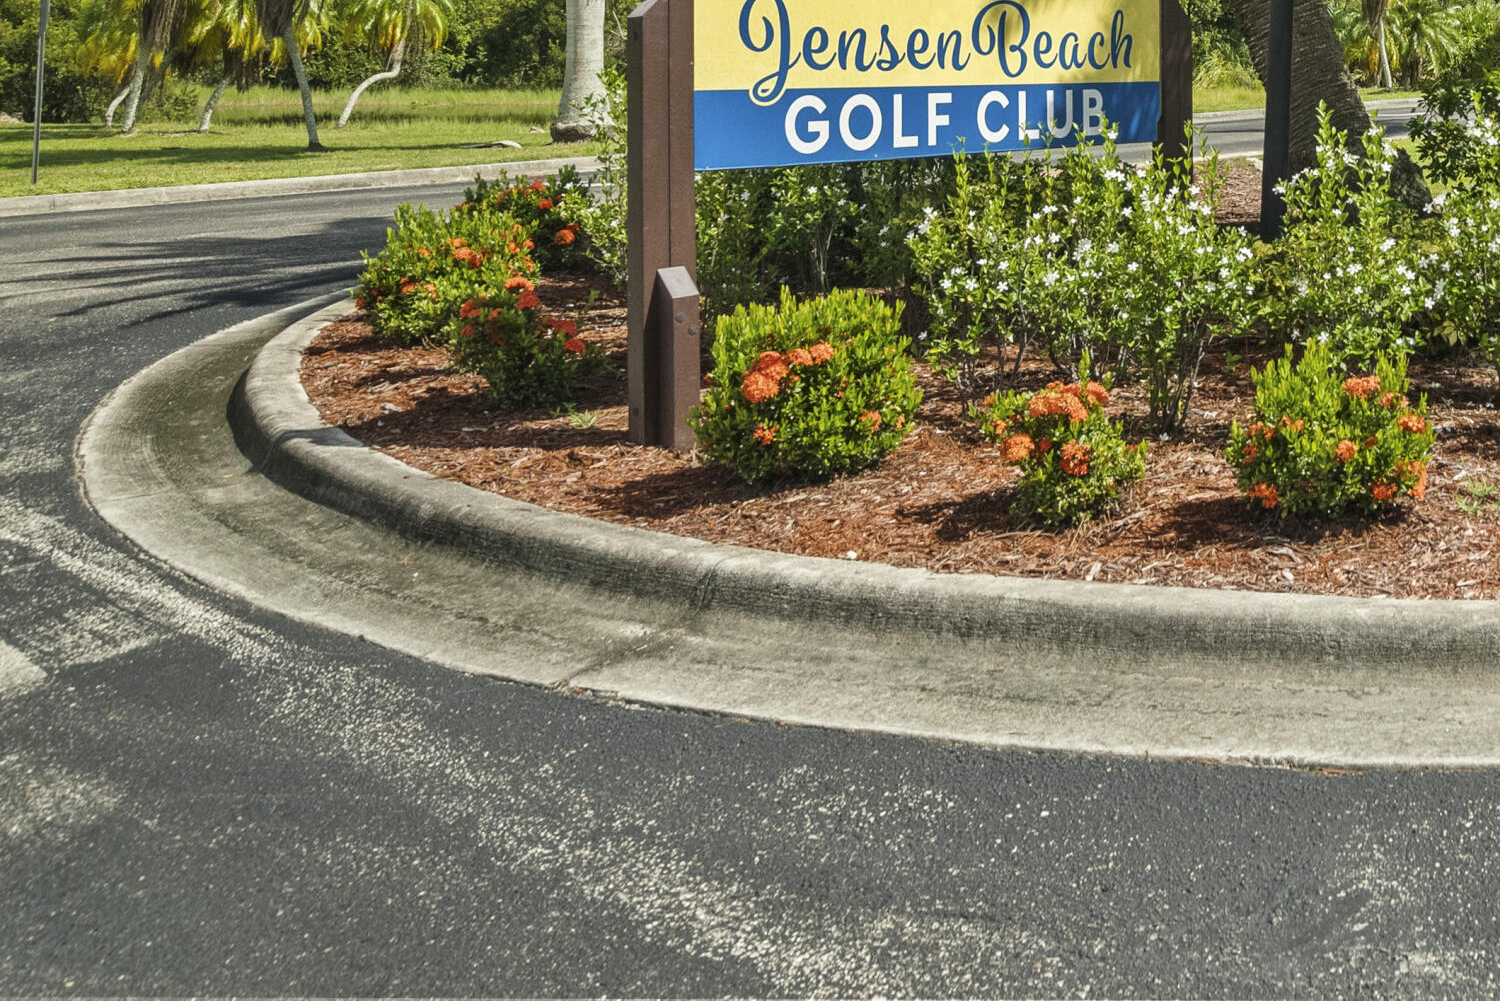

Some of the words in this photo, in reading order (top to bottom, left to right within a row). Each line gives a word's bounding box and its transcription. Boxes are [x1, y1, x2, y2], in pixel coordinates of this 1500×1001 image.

[971, 0, 1133, 78] Beach
[784, 92, 953, 154] GOLF
[976, 89, 1105, 143] CLUB
